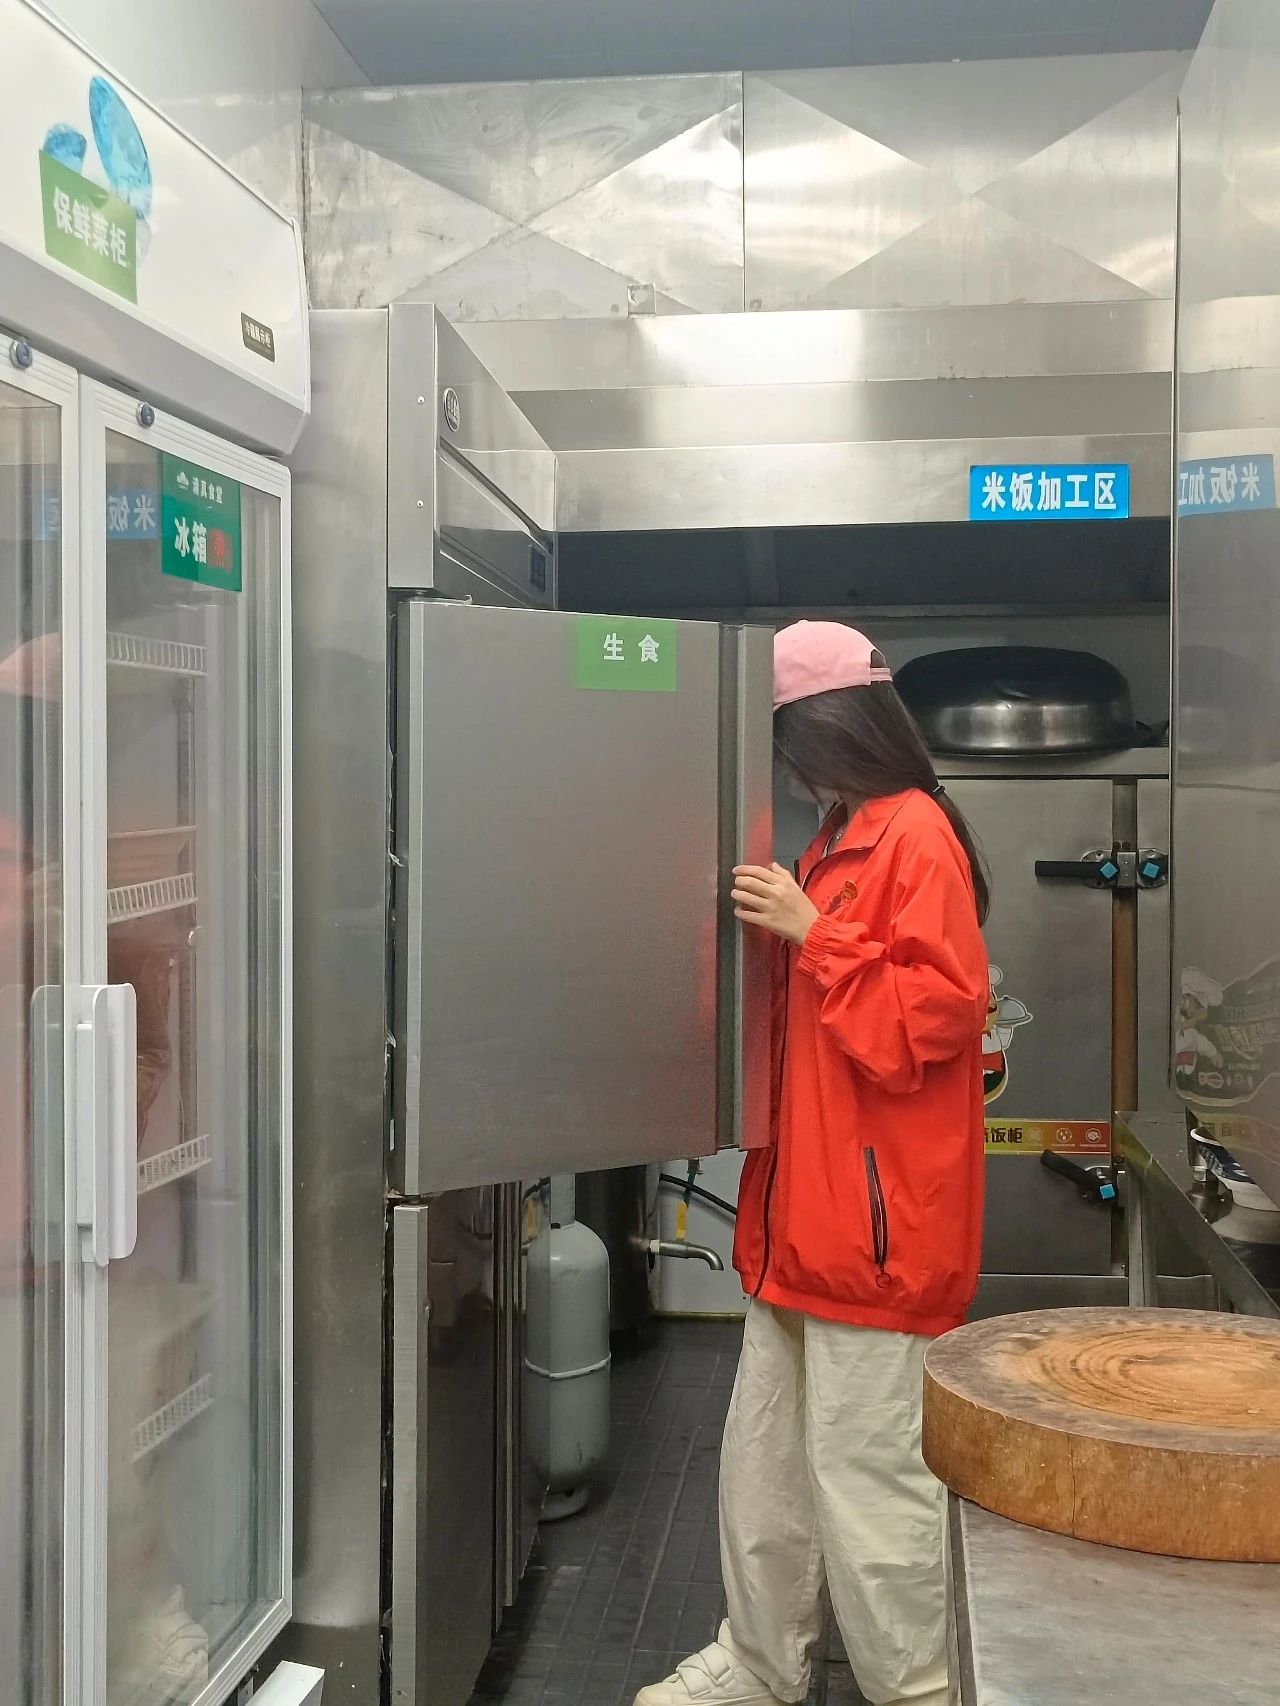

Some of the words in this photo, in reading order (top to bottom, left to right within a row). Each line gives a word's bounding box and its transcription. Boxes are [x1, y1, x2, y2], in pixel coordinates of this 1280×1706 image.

[53, 186, 129, 268] 保鲜菜柜
[981, 471, 1117, 512] 米饭加工区
[603, 632, 660, 663] 生食
